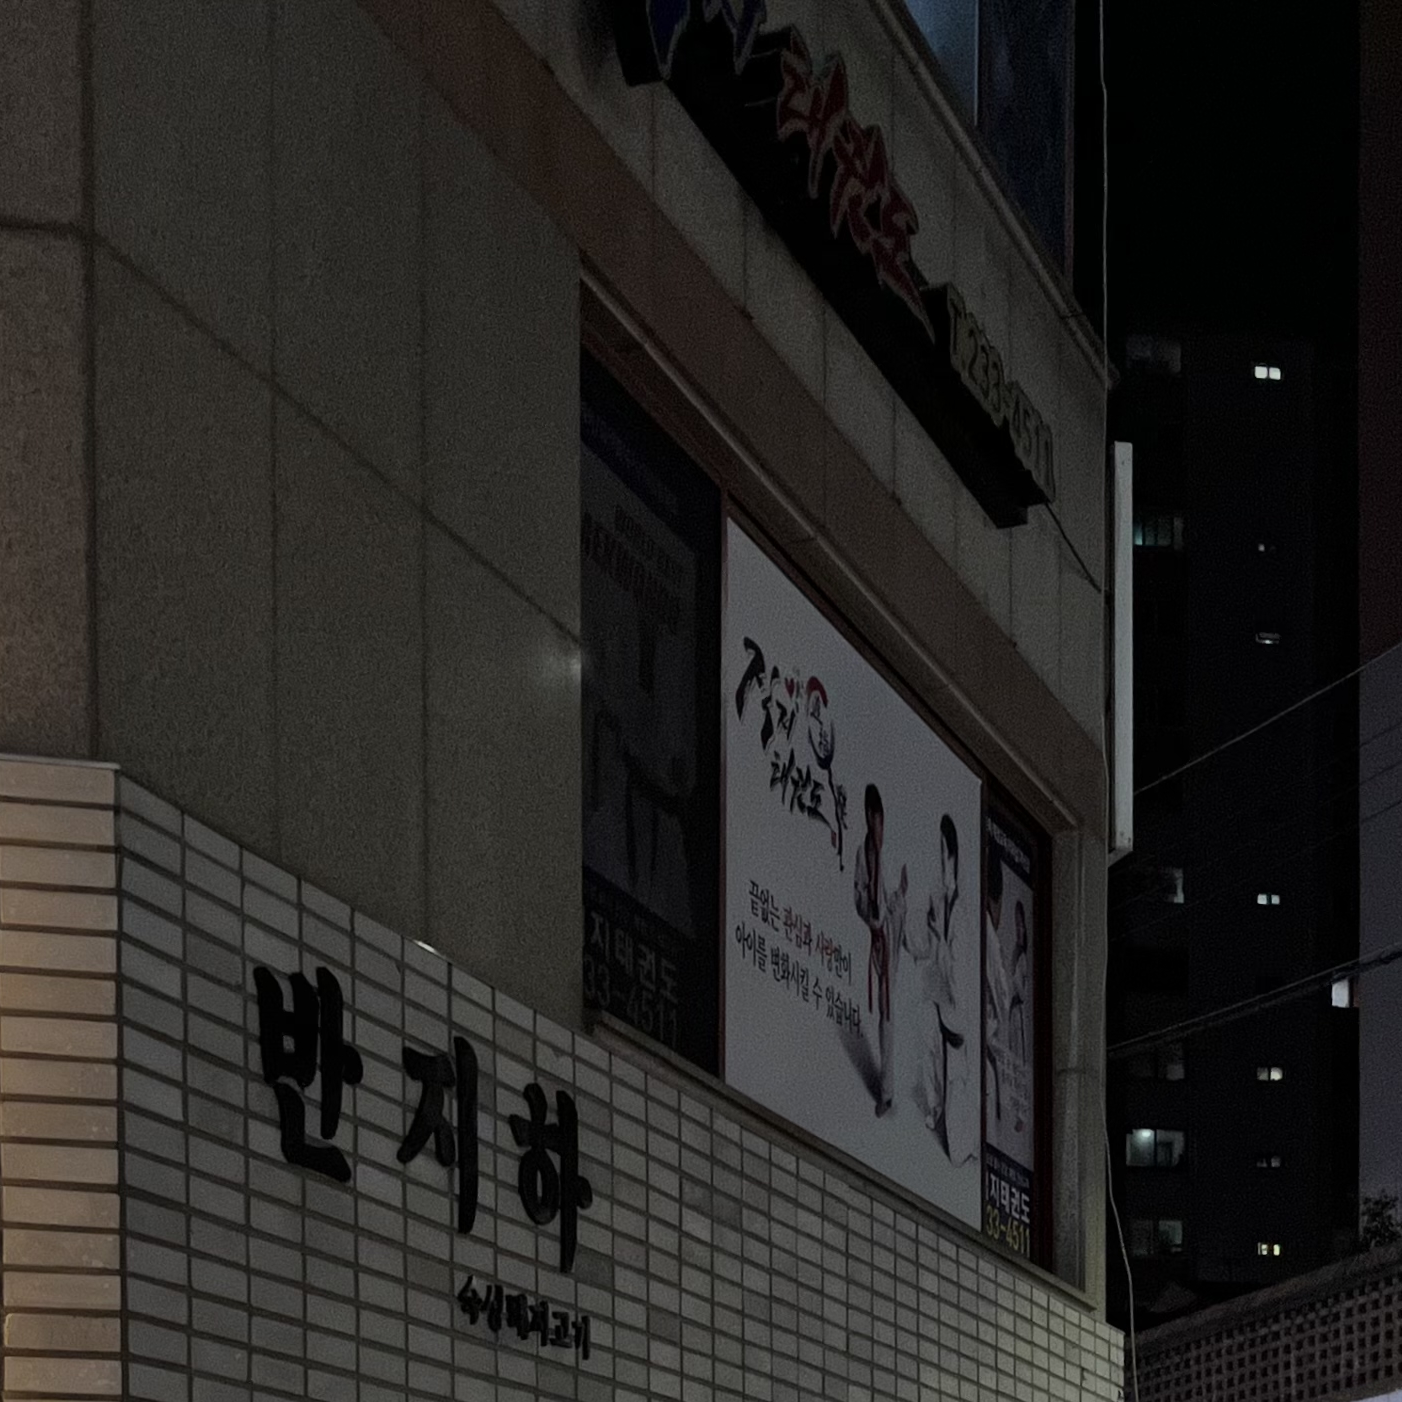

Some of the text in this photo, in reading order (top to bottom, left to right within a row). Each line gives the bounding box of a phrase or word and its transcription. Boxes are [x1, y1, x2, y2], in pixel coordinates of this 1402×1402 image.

[735, 920, 768, 973] 아이를
[770, 945, 810, 1003] 변화시킬
[812, 976, 823, 1011] 수
[824, 985, 865, 1038] 있습니다.
[748, 879, 781, 932] 끝없는
[782, 905, 813, 957] 관심과
[814, 929, 852, 987] 사랑만이
[253, 965, 594, 1275] 반지하
